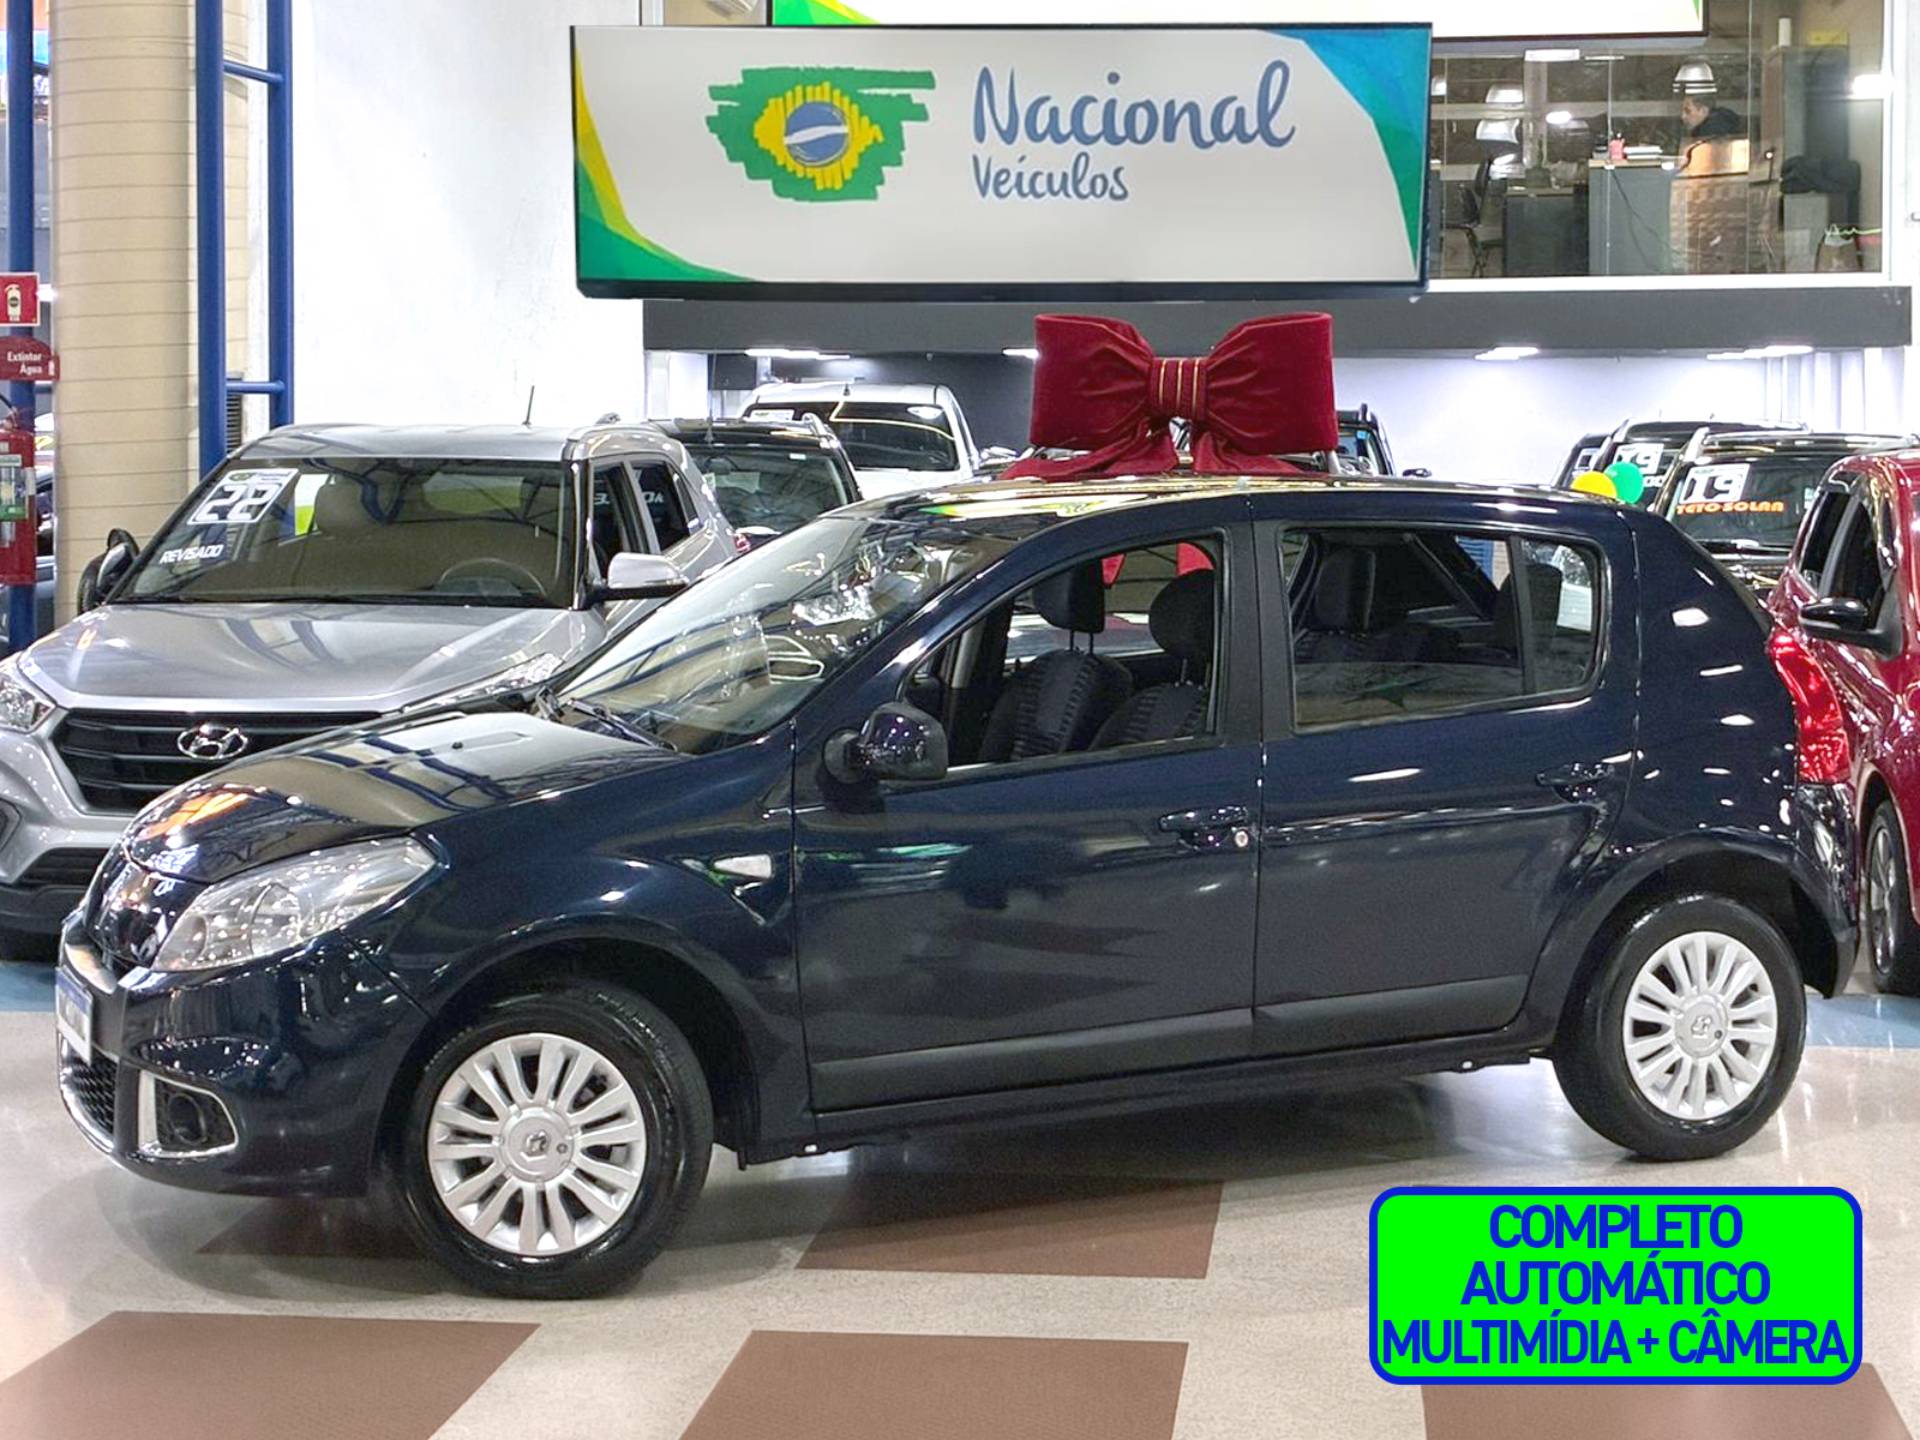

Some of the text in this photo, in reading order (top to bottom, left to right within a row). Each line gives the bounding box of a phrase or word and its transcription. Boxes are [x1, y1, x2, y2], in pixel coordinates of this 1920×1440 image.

[974, 60, 1295, 149] Nacional
[973, 152, 1128, 201] Veículos
[7, 351, 42, 361] Extintor
[196, 483, 282, 522] 22
[1684, 475, 1743, 500] 19
[160, 545, 223, 564] REVISADO
